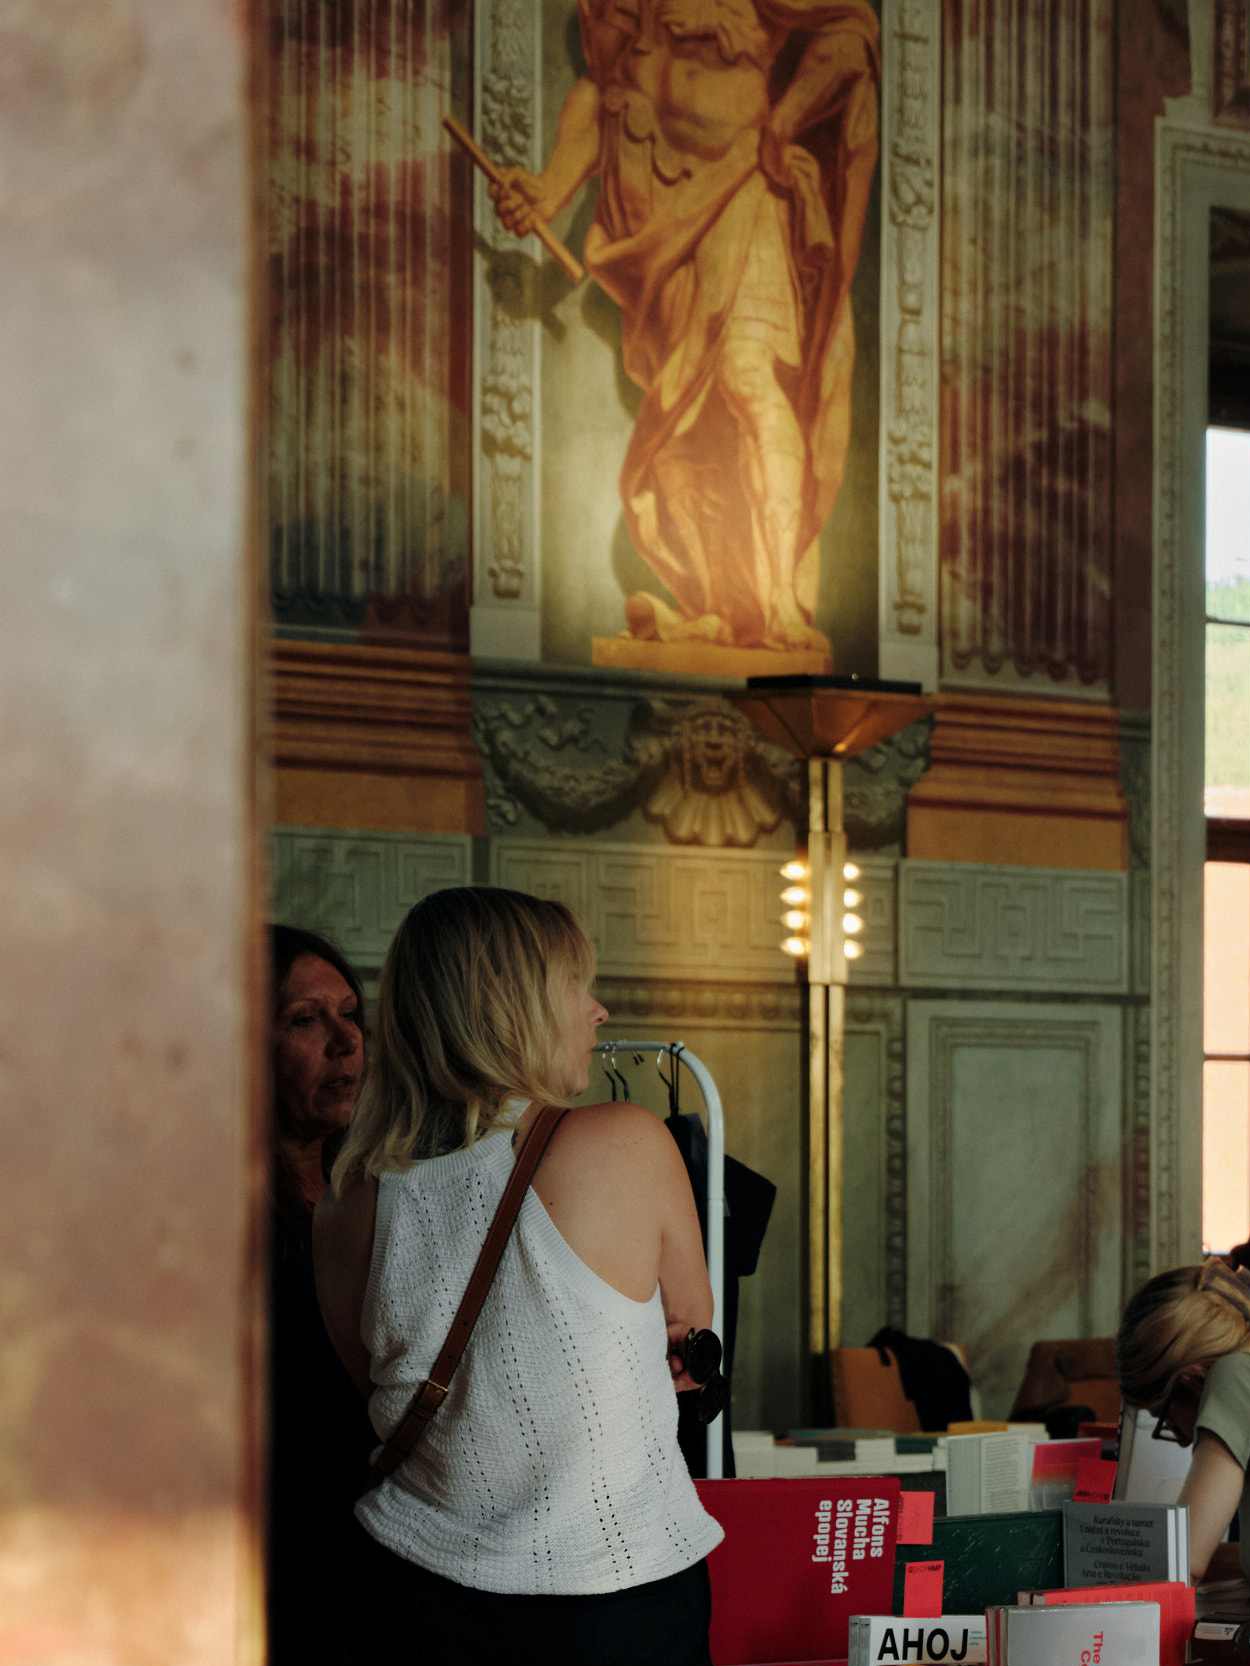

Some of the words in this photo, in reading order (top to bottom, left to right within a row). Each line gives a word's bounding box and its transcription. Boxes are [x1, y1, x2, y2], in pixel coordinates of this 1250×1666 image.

[814, 1499, 832, 1562] epopej
[830, 1498, 854, 1594] Slovanská
[852, 1498, 872, 1561] Mucha
[871, 1498, 890, 1558] Alfons
[877, 1627, 969, 1662] AHOJ
[1092, 1631, 1104, 1663] The
